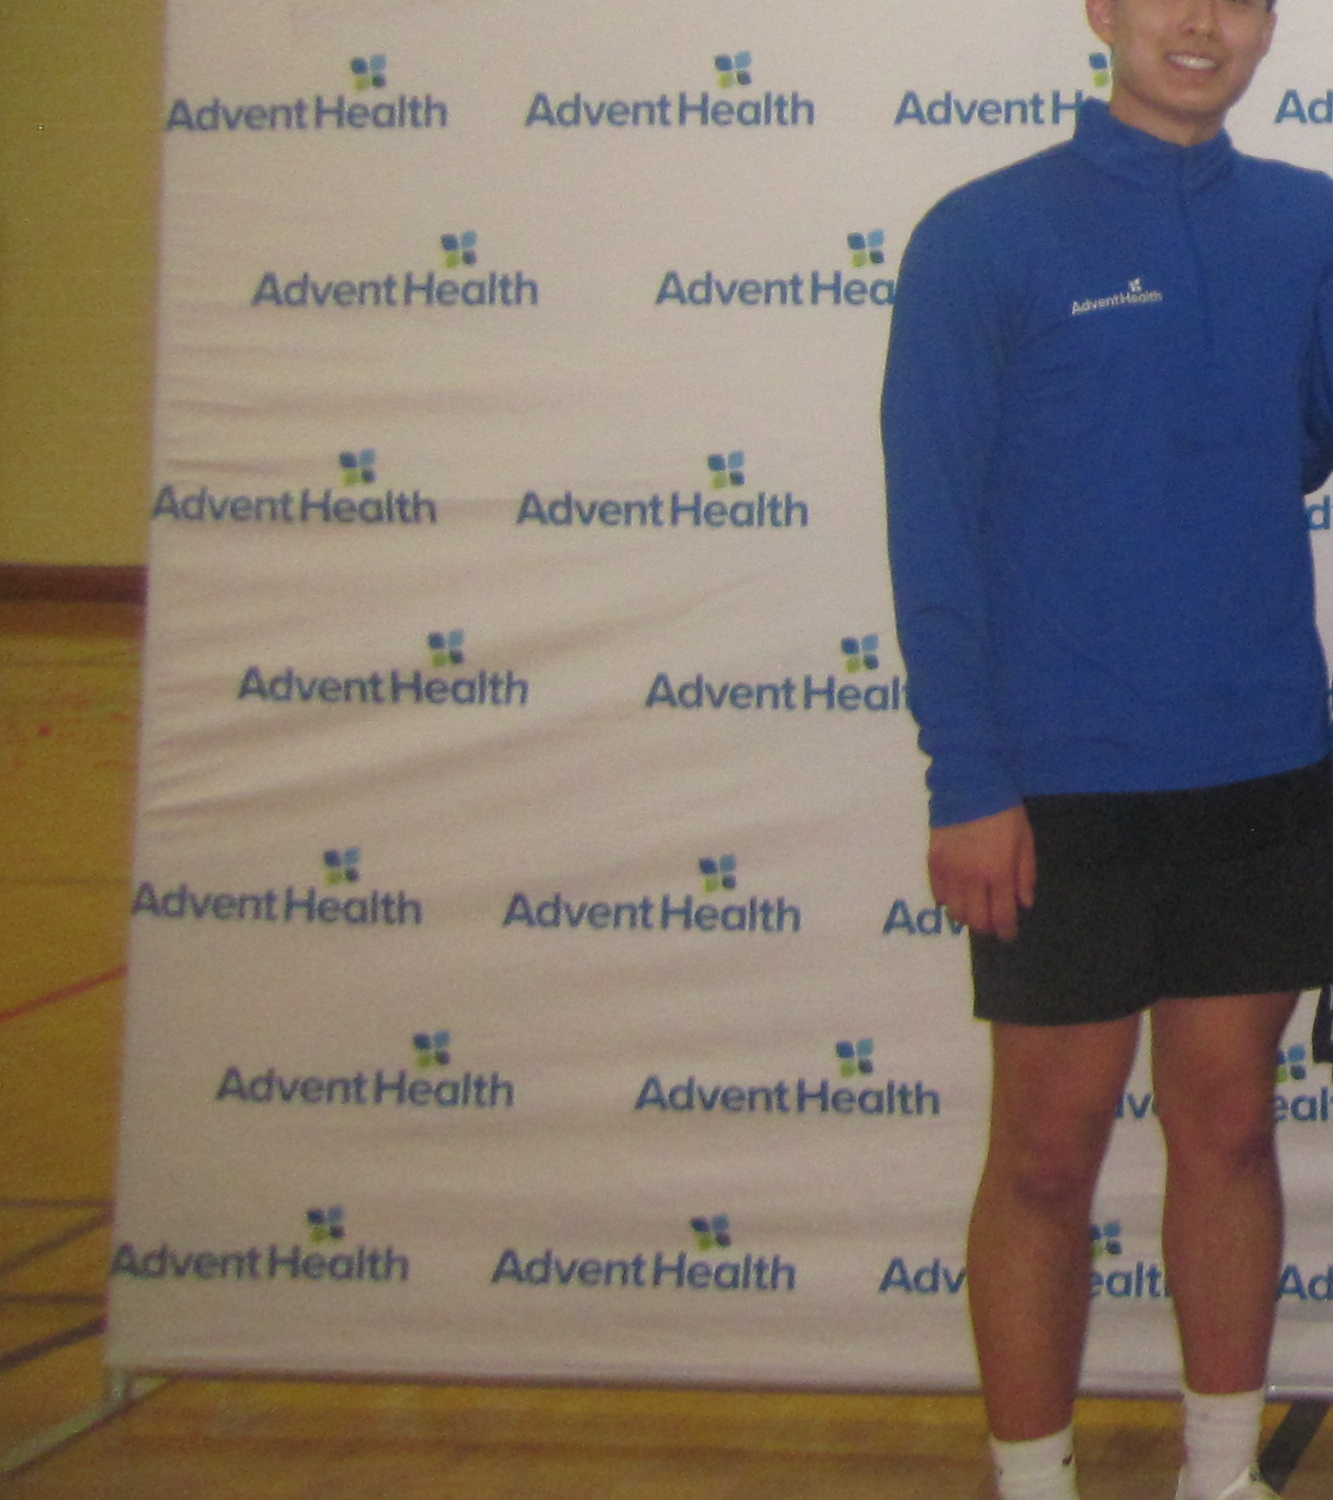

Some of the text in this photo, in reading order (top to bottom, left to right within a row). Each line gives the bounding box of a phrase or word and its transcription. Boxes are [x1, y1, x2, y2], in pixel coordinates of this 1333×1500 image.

[168, 94, 449, 131] AdventHealth
[526, 89, 817, 129] AdventHealth
[893, 88, 1084, 126] AdventH
[253, 269, 541, 307] AdventHealth
[654, 269, 897, 306] AdventHea
[154, 485, 437, 523] AdventHealth
[517, 489, 809, 529] AdventHealth
[240, 666, 530, 706] AdventHealth
[645, 671, 908, 712] AdventHeal
[131, 881, 424, 926] AdventHealth
[505, 892, 803, 933] AdventHealth
[215, 1066, 515, 1108] AdventHealth
[635, 1074, 942, 1116] AdventHealth
[108, 1242, 411, 1283] AdventHealth
[494, 1248, 797, 1291] AdventHealth
